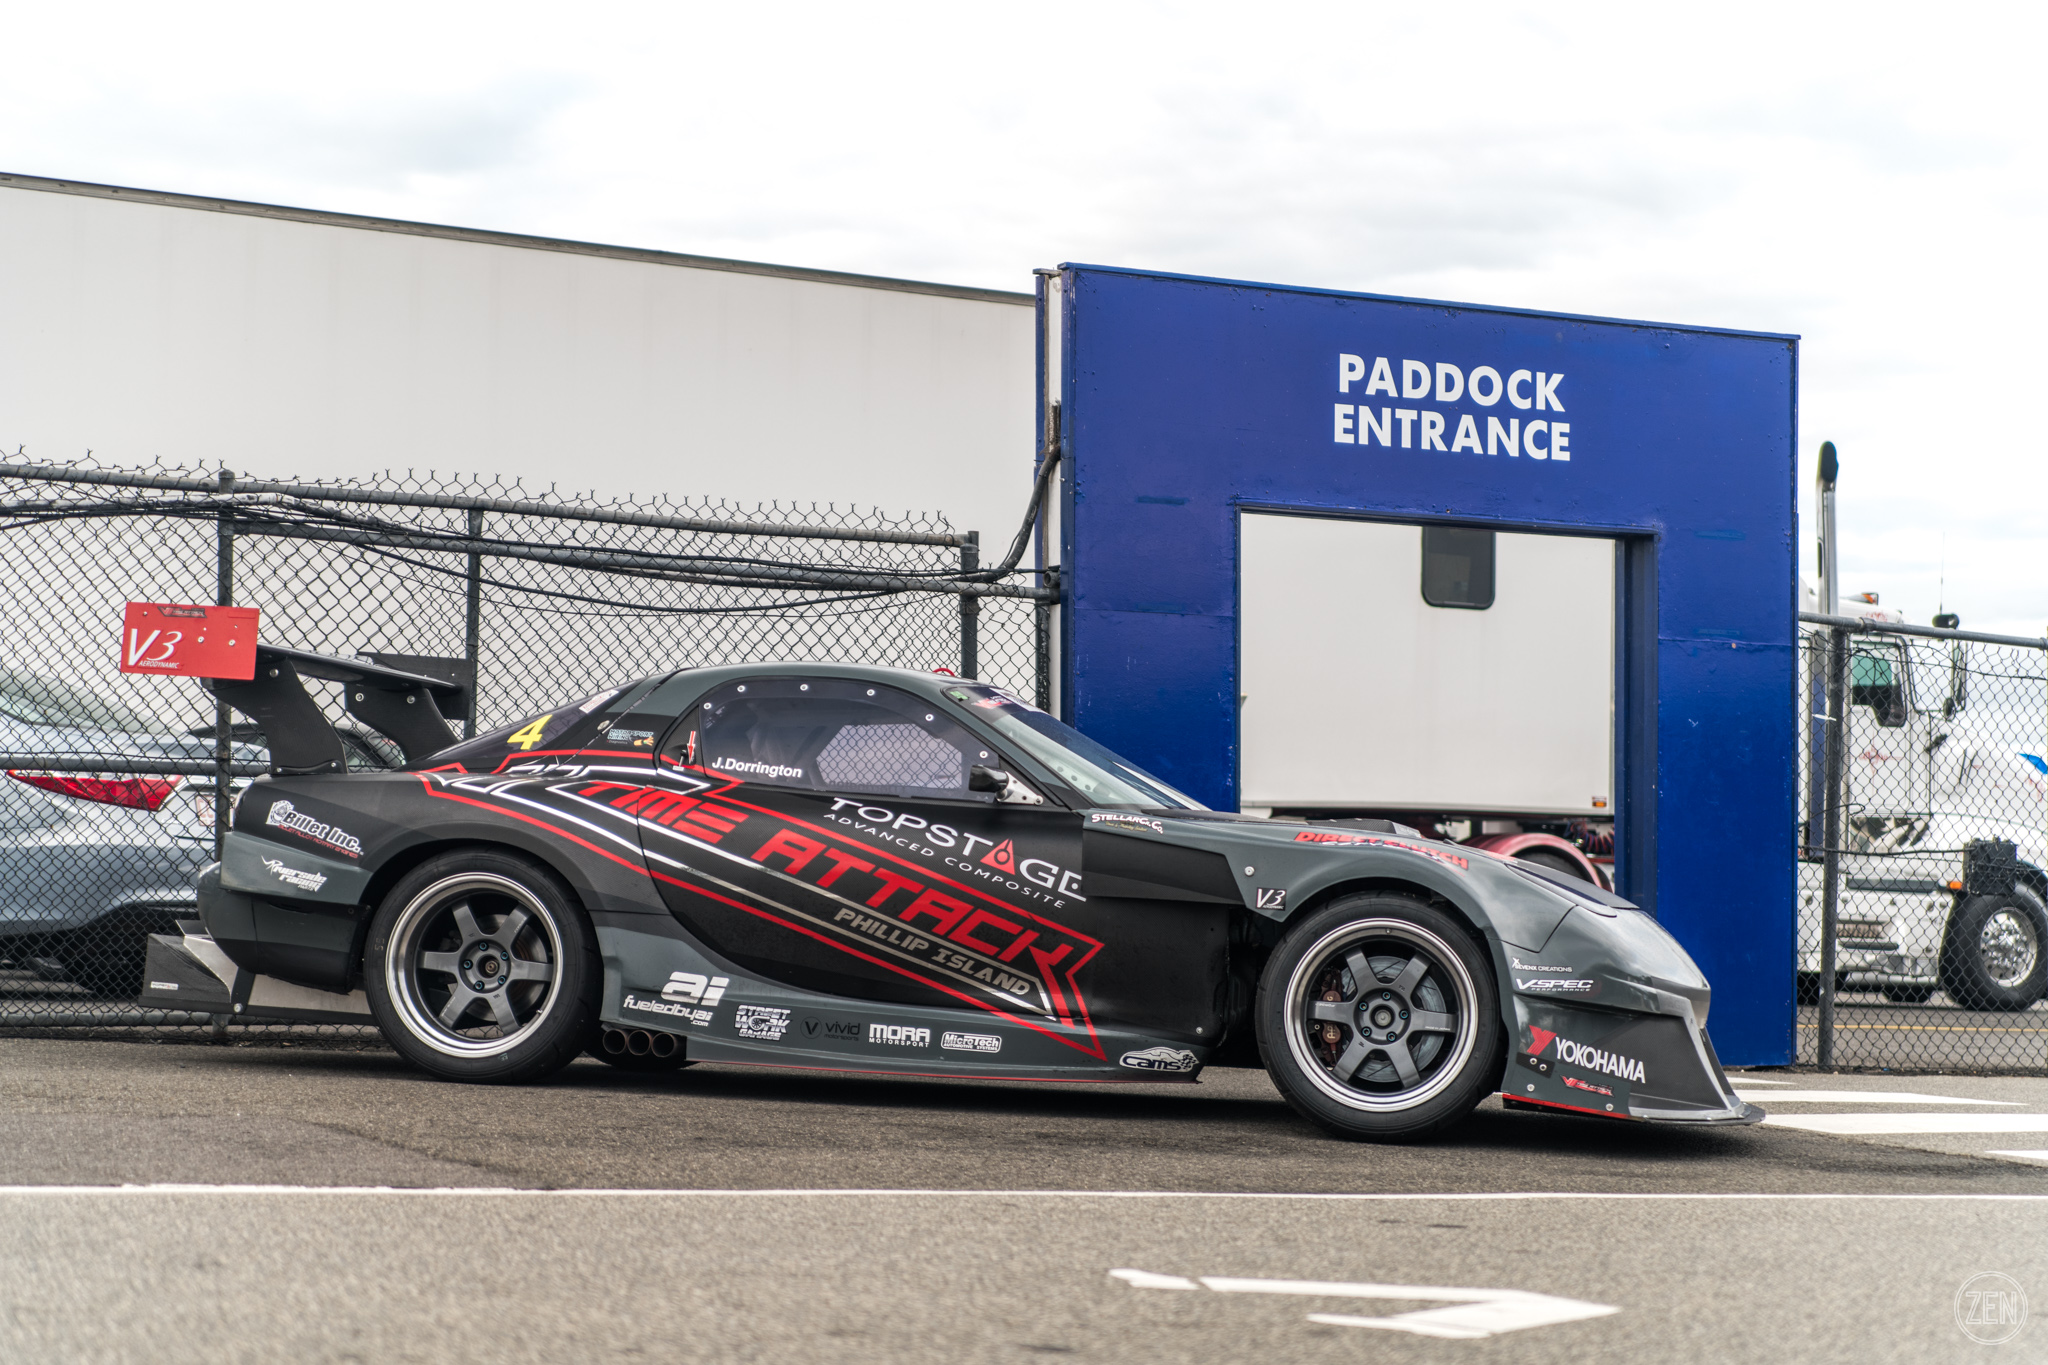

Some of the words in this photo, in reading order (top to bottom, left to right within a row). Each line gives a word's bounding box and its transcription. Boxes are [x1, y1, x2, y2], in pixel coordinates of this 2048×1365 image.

[1339, 353, 1565, 412] PADDOCK
[1334, 403, 1570, 461] ENTRANCE
[128, 628, 182, 666] V3
[138, 660, 180, 669] AERODYNAMIC
[506, 715, 552, 750] 4
[712, 757, 802, 778] J.Dorrington
[281, 810, 329, 839] Billet
[326, 827, 362, 853] Inc.
[824, 813, 933, 857] ADVANCED
[945, 857, 1065, 909] COMPOSITE
[831, 797, 1087, 902] TOPSTAGE
[1294, 831, 1380, 844] DIRECT
[1382, 839, 1469, 871] CLUTCH
[578, 781, 749, 843] TIME
[751, 829, 1075, 1027] ATTACK
[1257, 889, 1286, 908] V3
[834, 908, 930, 951] PHILLIP
[930, 949, 1031, 995] ISLAND
[660, 971, 730, 1007] ai
[623, 995, 714, 1021] fueledbyai
[691, 1019, 709, 1027] .com
[736, 1005, 791, 1019] STREET
[738, 1029, 782, 1041] GARAGE
[824, 1033, 859, 1042] motorsports
[825, 1022, 861, 1036] vivid
[869, 1023, 931, 1042] MORA
[869, 1037, 930, 1048] MOTORSPORT
[944, 1034, 999, 1048] MicroTech
[1555, 1036, 1646, 1084] YOKOHAMA
